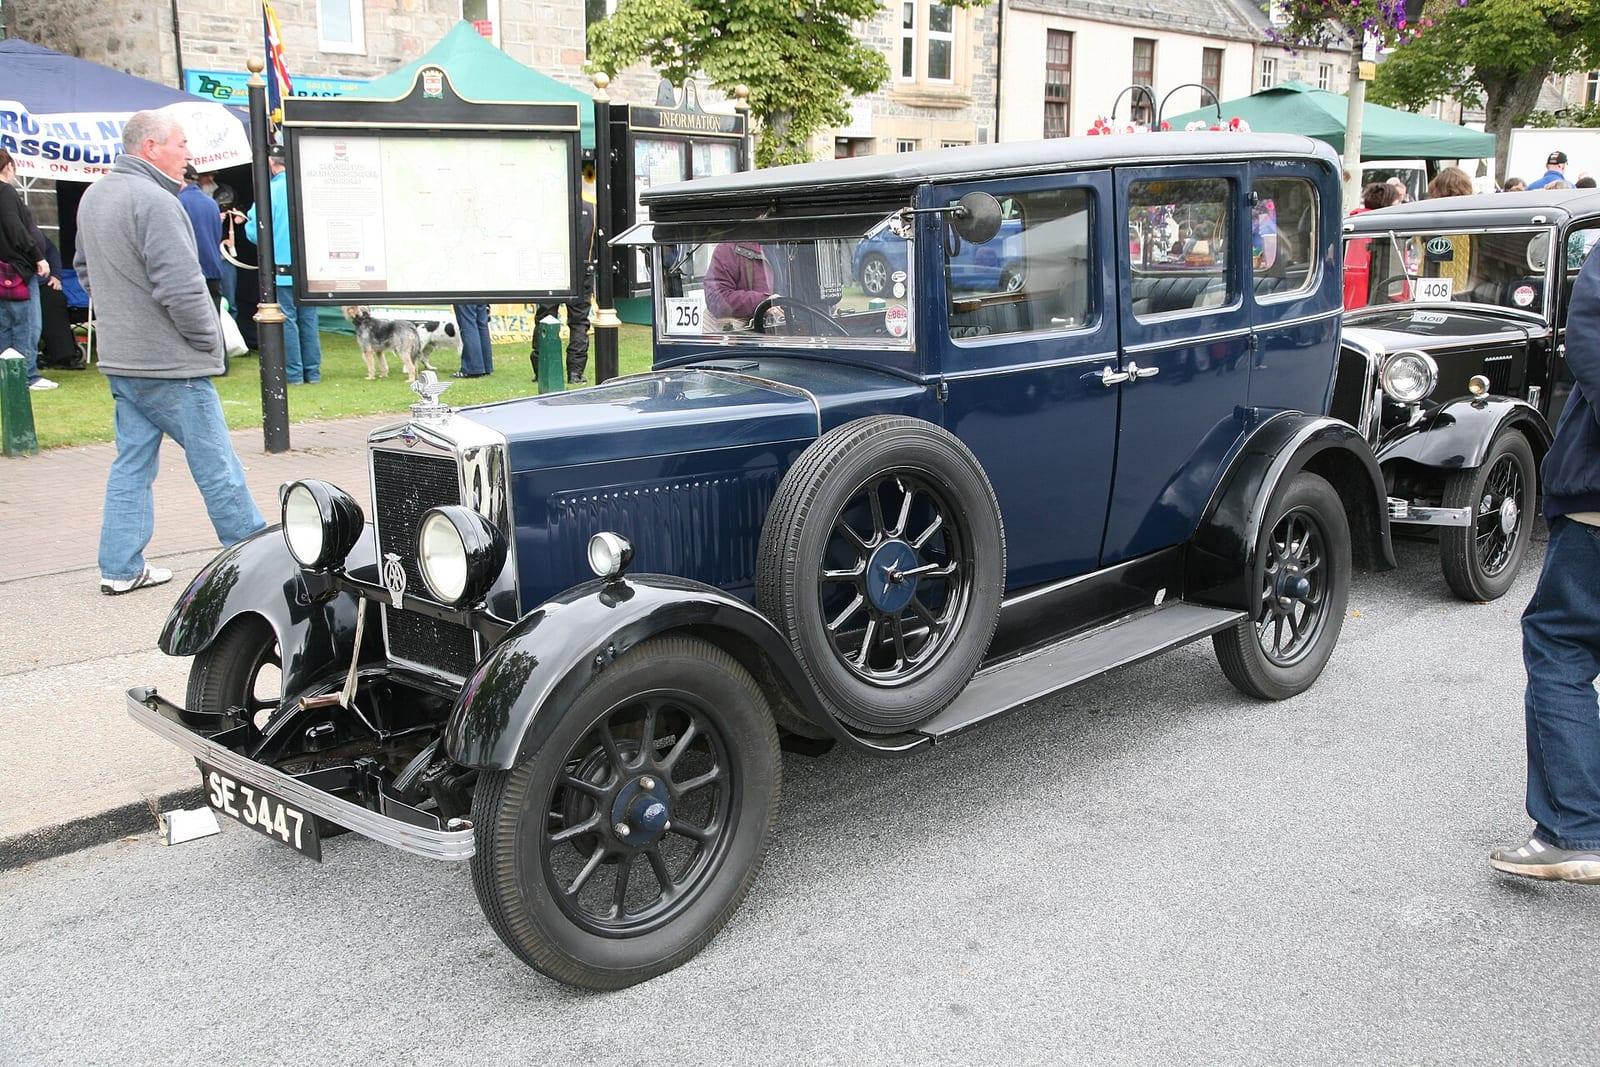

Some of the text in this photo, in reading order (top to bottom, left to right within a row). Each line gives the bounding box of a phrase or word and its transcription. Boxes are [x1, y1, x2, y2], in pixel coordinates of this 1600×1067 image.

[0, 111, 91, 140] ROAL
[659, 111, 721, 130] INFORMATION
[193, 149, 239, 166] BRANCH
[49, 163, 69, 173] ON
[1424, 283, 1449, 297] 408
[675, 305, 700, 327] 256
[209, 771, 304, 850] SE 3447
